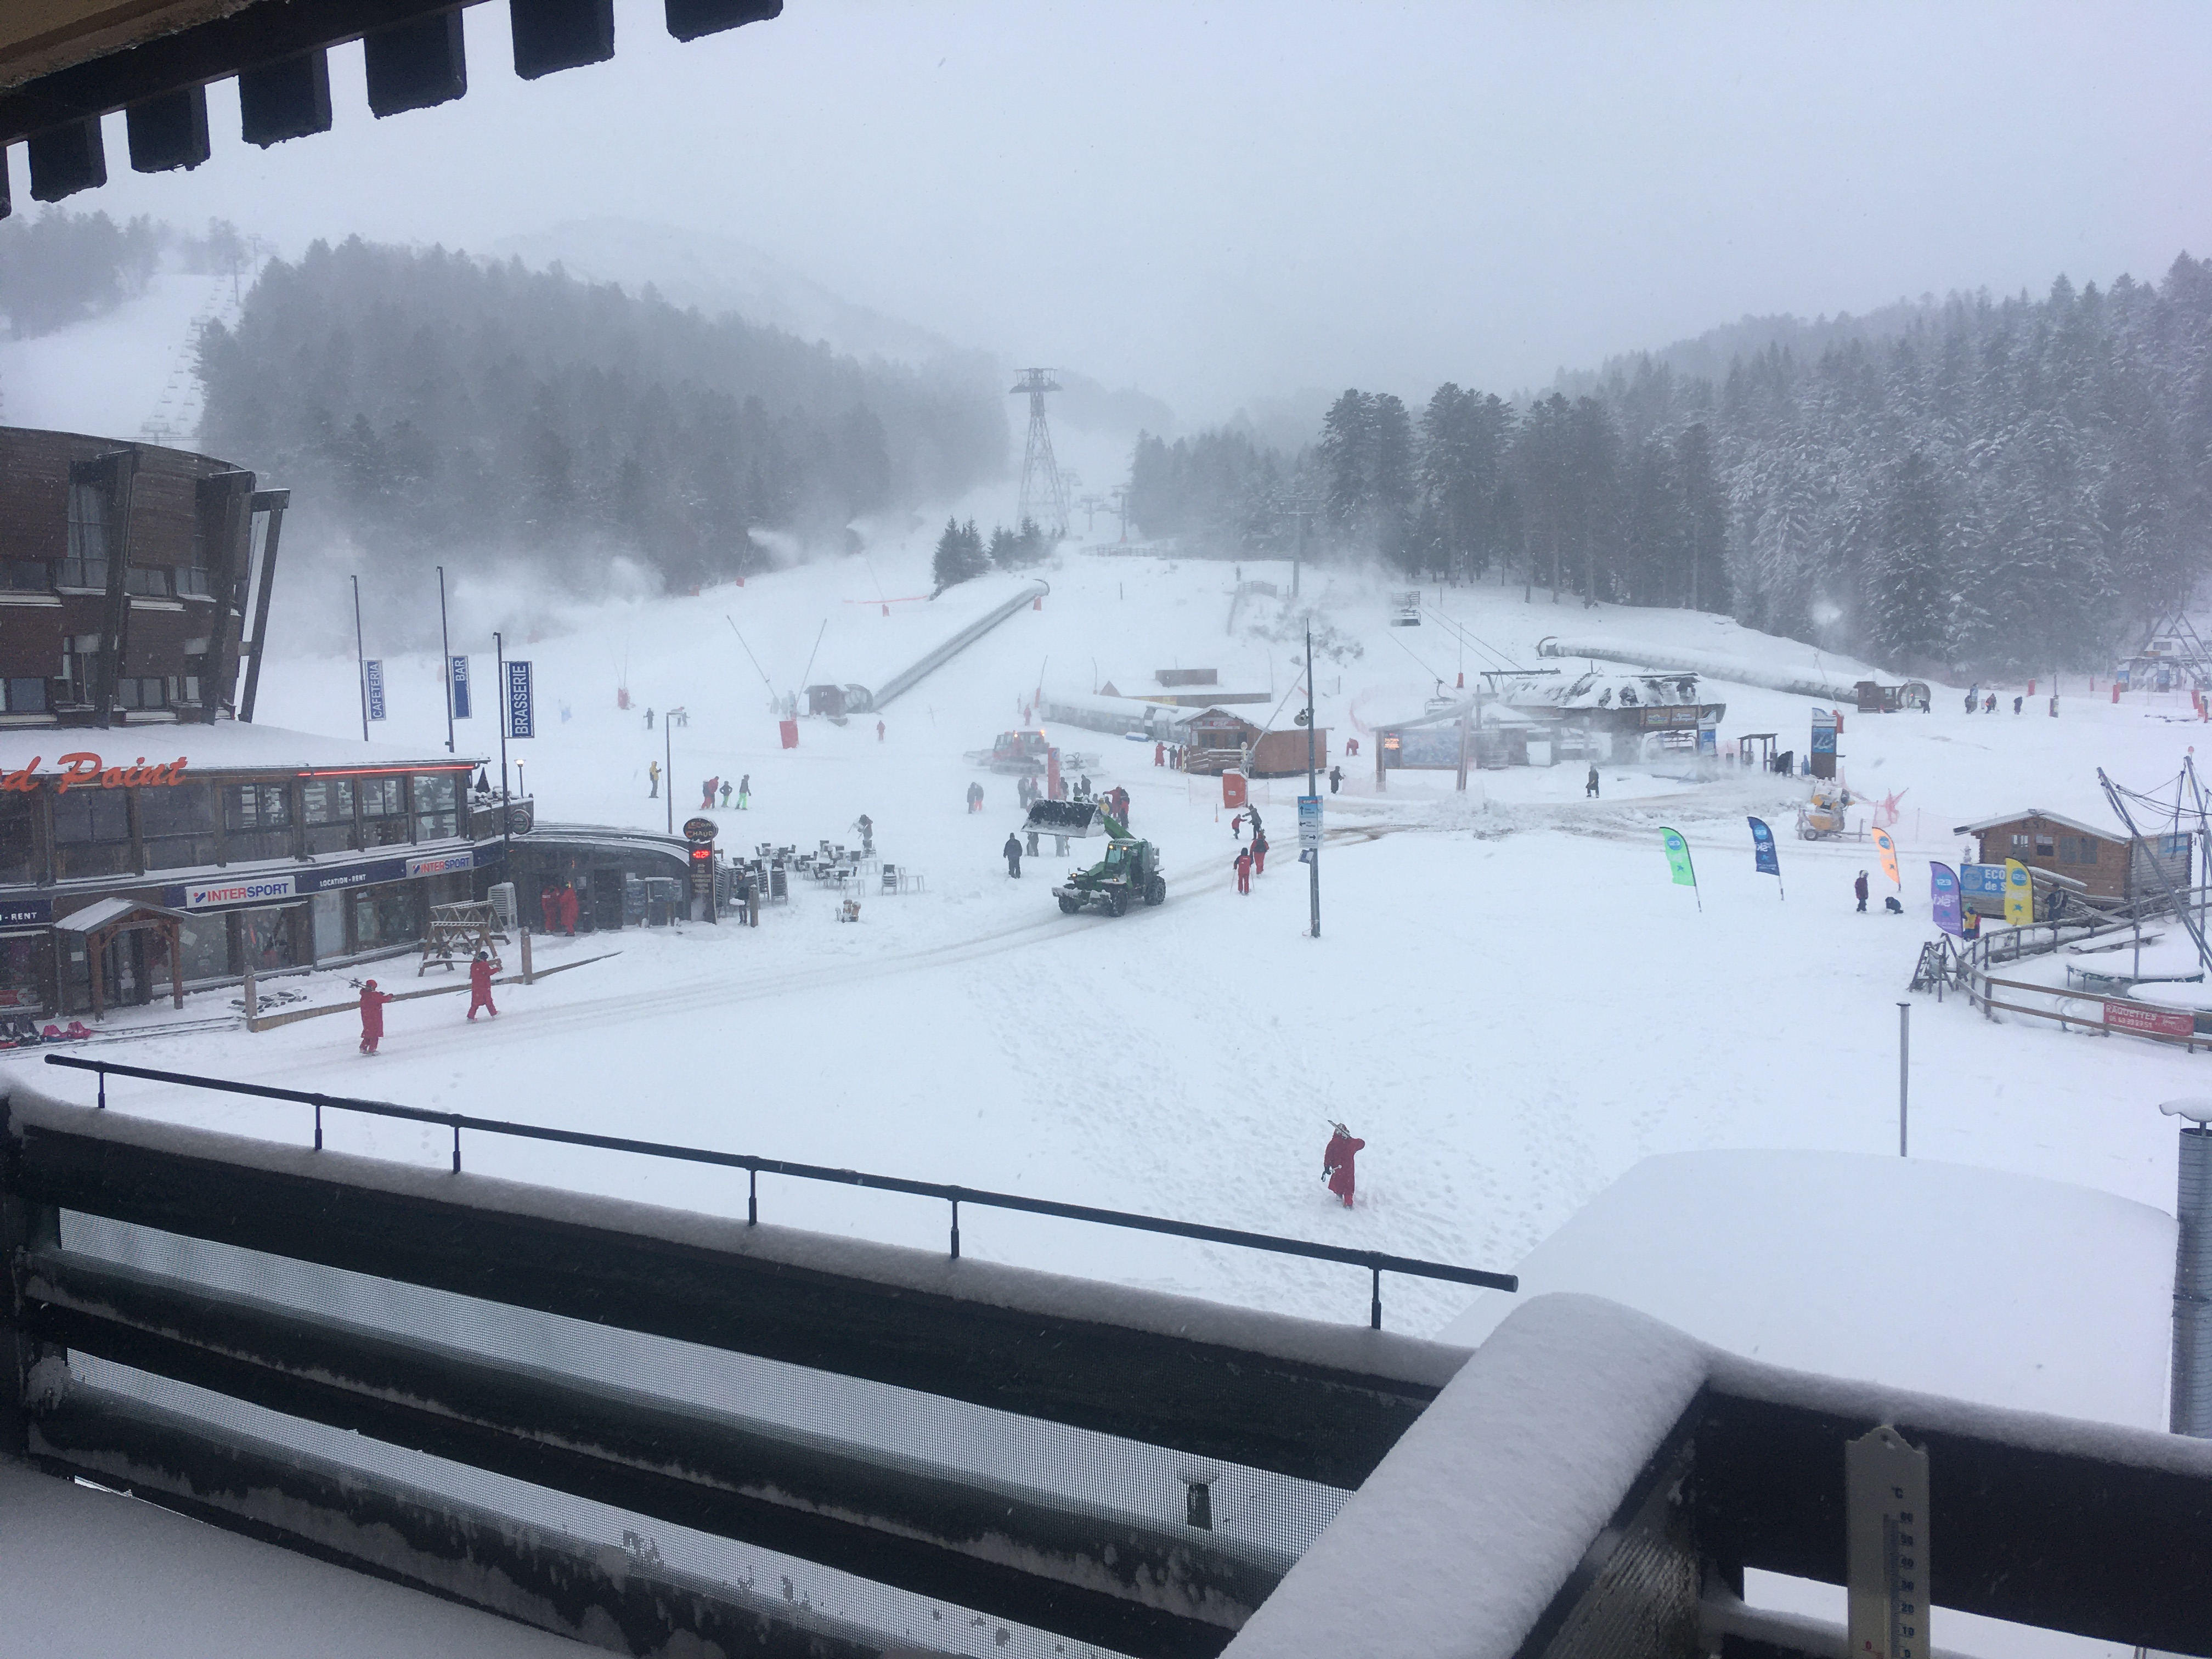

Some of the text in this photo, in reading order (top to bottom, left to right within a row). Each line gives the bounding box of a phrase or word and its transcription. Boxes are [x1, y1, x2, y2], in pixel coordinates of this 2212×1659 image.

[455, 659, 465, 681] BAR
[370, 663, 382, 718] CAFETERIA
[512, 665, 528, 735] BRASSERIE
[0, 751, 188, 794] d Point
[421, 857, 470, 873] INTERSPORT
[320, 877, 348, 887] LOCATION
[352, 874, 366, 882] RENT
[1985, 881, 1997, 891] de
[207, 883, 289, 902] INTERSPORT
[11, 912, 37, 921] RENT
[2106, 1005, 2157, 1021] RAQUETTES
[1901, 1603, 1914, 1613] 20
[1903, 1626, 1914, 1637] 10
